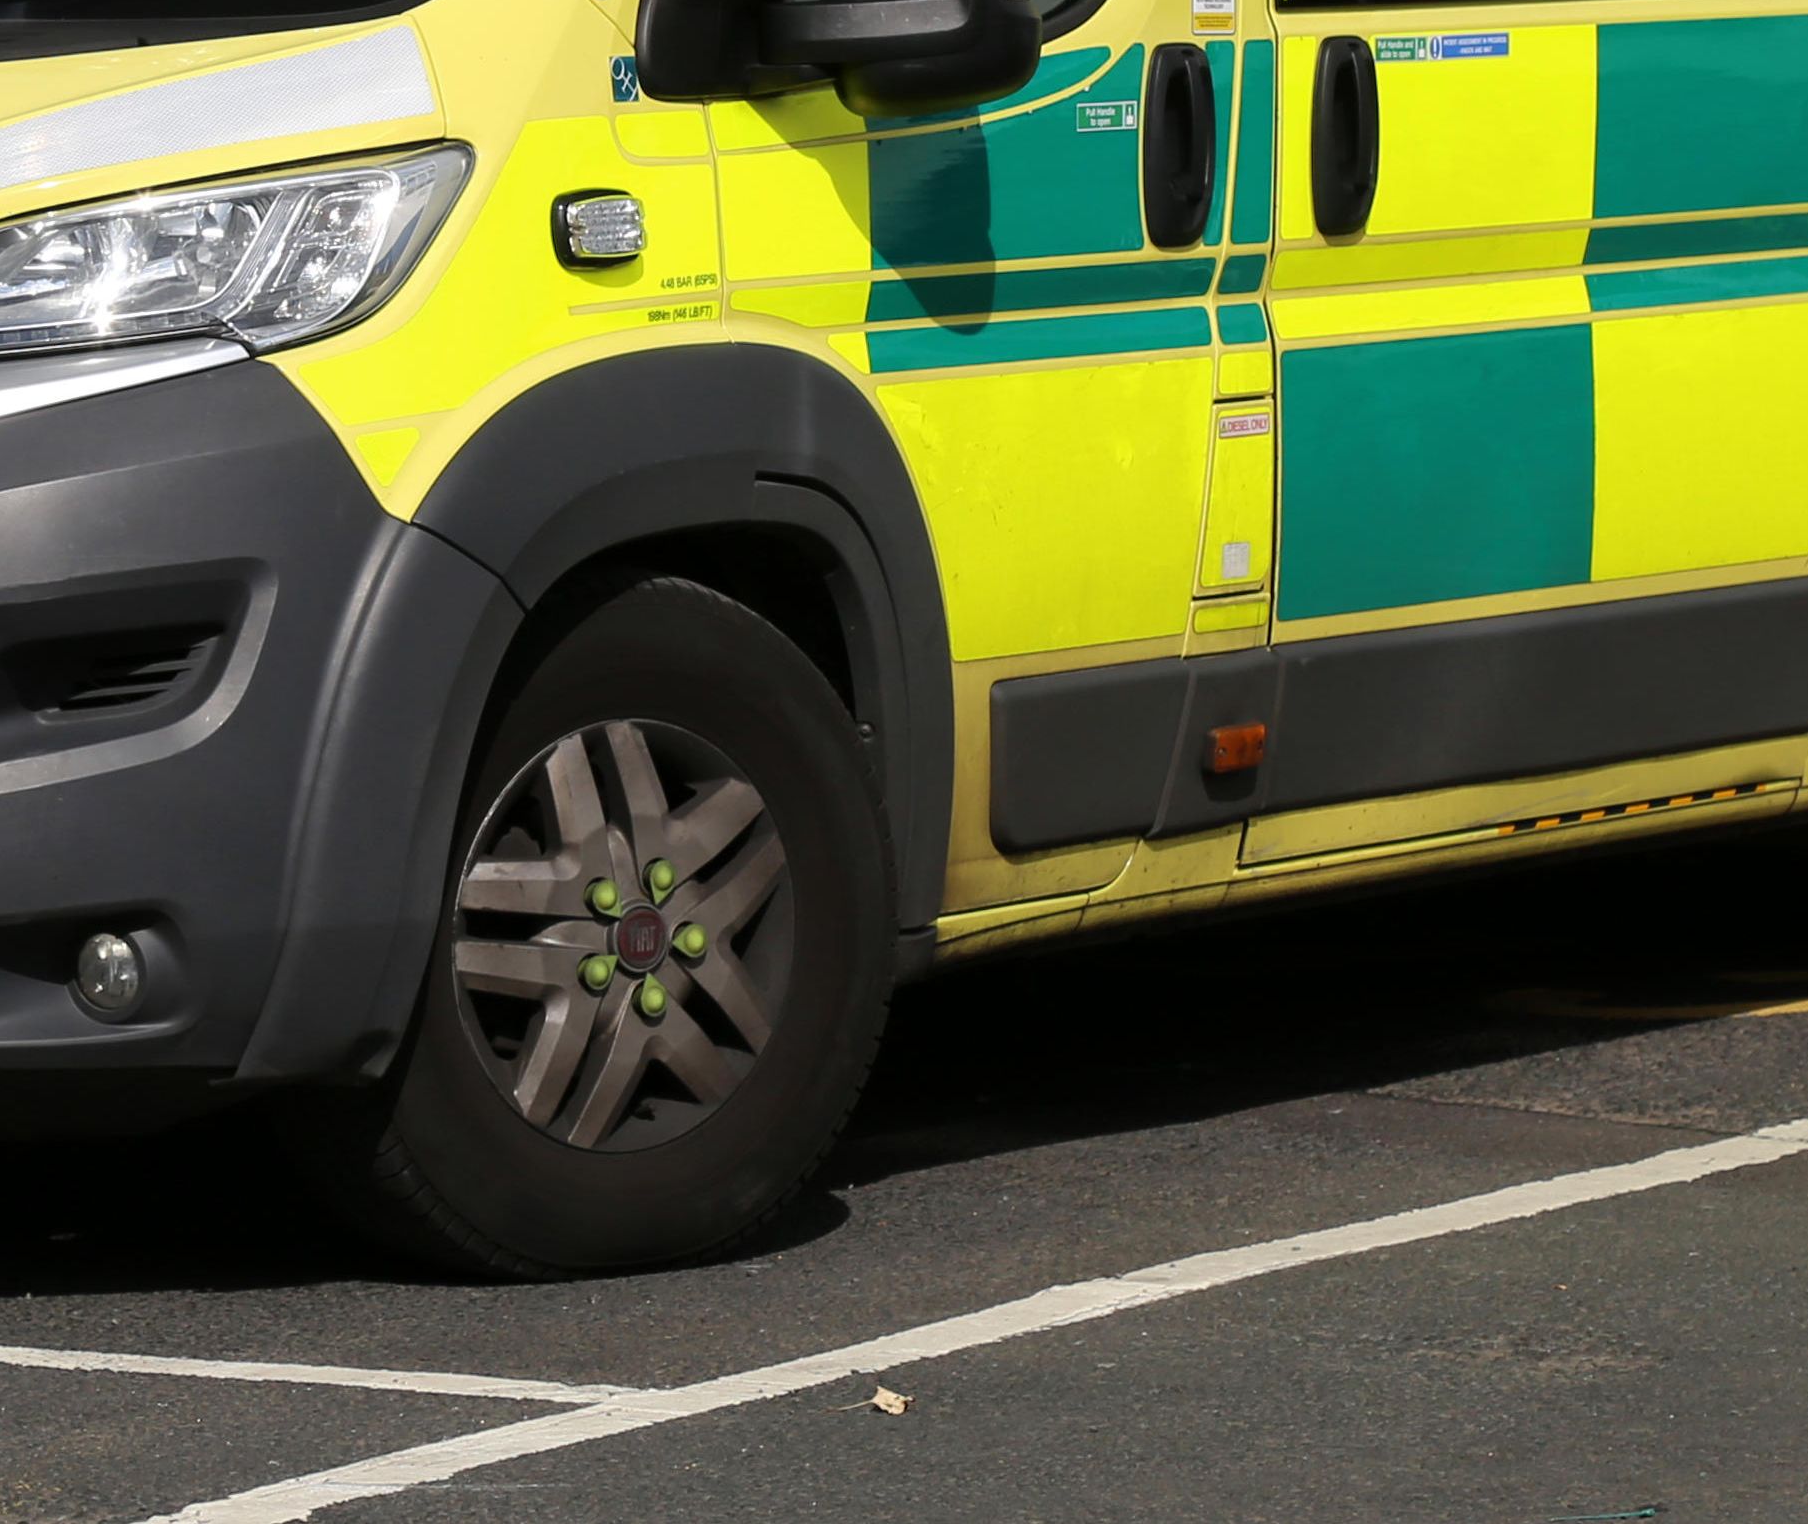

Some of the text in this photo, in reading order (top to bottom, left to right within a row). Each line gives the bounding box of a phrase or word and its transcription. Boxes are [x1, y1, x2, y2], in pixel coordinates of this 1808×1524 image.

[676, 275, 692, 288] BAR
[1227, 417, 1267, 433] DIESEL ONLY
